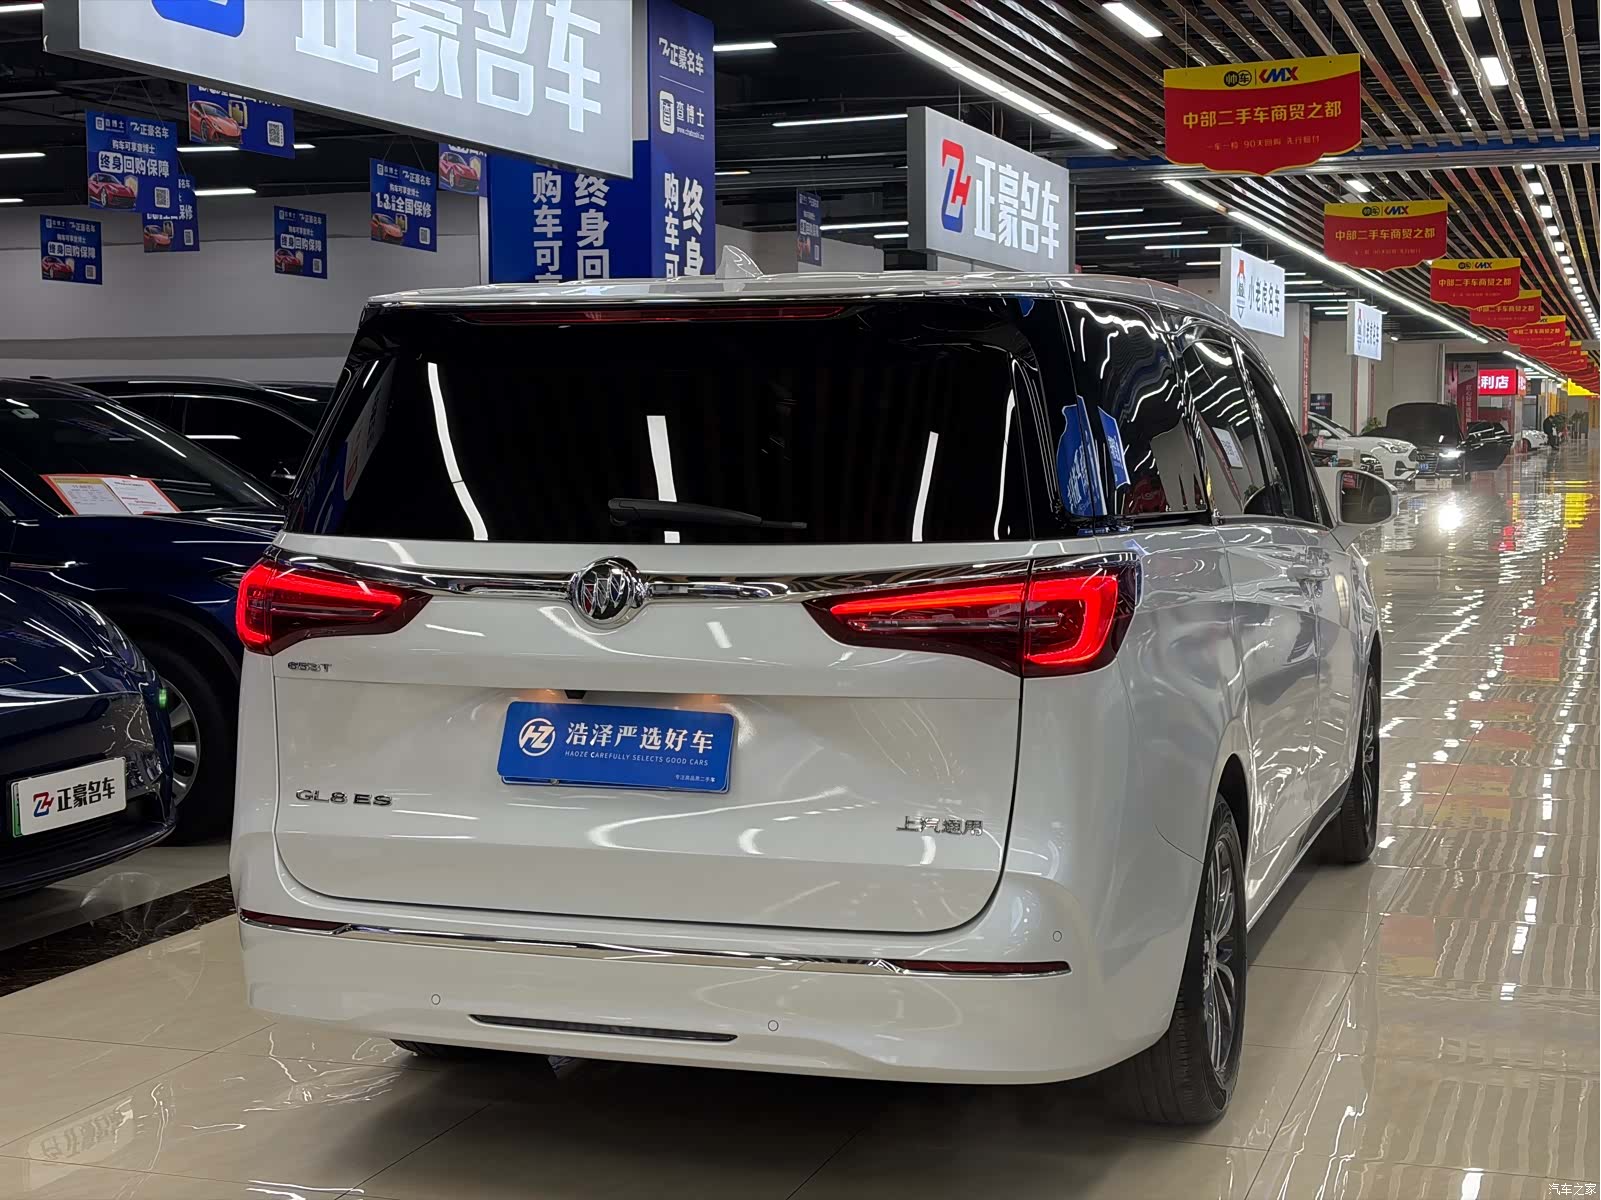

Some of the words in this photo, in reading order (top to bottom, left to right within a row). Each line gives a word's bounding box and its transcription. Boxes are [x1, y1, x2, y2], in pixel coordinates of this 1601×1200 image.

[669, 43, 704, 76] 正豪名车
[676, 101, 704, 127] 查博士
[1183, 101, 1342, 129] 中部二手车商贸之都
[140, 123, 169, 139] 正豪名车
[112, 139, 156, 154] 购车可享查博士
[100, 152, 170, 178] 终身回购保障
[974, 155, 1060, 259] 正豪名车
[1335, 228, 1436, 241] 中部二手车商贸之都
[1478, 375, 1509, 390] 利店
[565, 721, 714, 754] 浩泽严选好车
[565, 750, 588, 758] HAOZE
[590, 751, 631, 761] CAREFULLY
[632, 754, 664, 764] SELECTS
[665, 757, 687, 765] GOOD
[689, 758, 709, 767] CARS
[57, 777, 116, 812] 正豪名车
[296, 789, 348, 804] GL8
[353, 793, 393, 807] ES
[896, 815, 983, 836] 上汽通用
